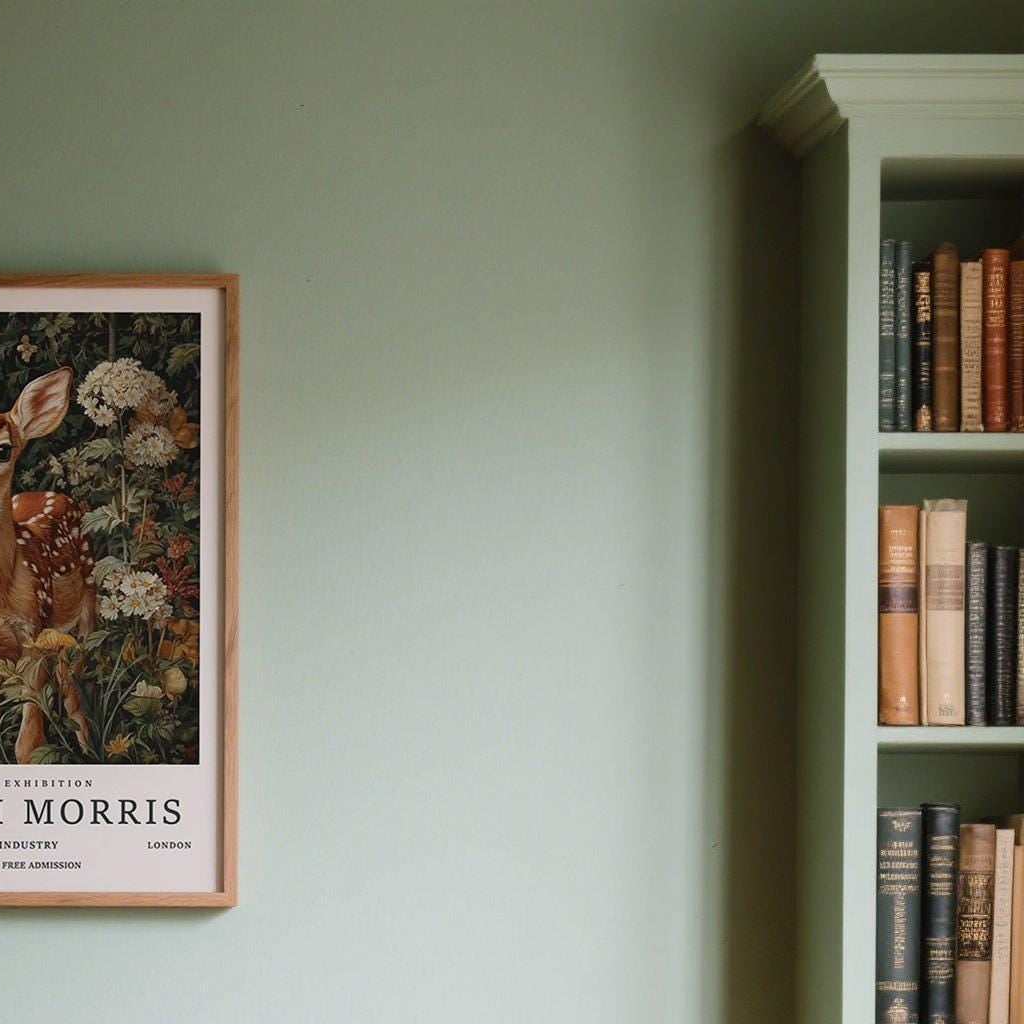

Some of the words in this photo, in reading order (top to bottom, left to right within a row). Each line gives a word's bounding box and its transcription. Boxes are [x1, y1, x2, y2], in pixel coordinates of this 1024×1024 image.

[4, 779, 93, 788] EXHIBITION
[23, 798, 181, 826] MORRIS
[147, 841, 192, 850] LONDON
[1, 861, 27, 870] FREE
[28, 860, 82, 870] ADMISSION
